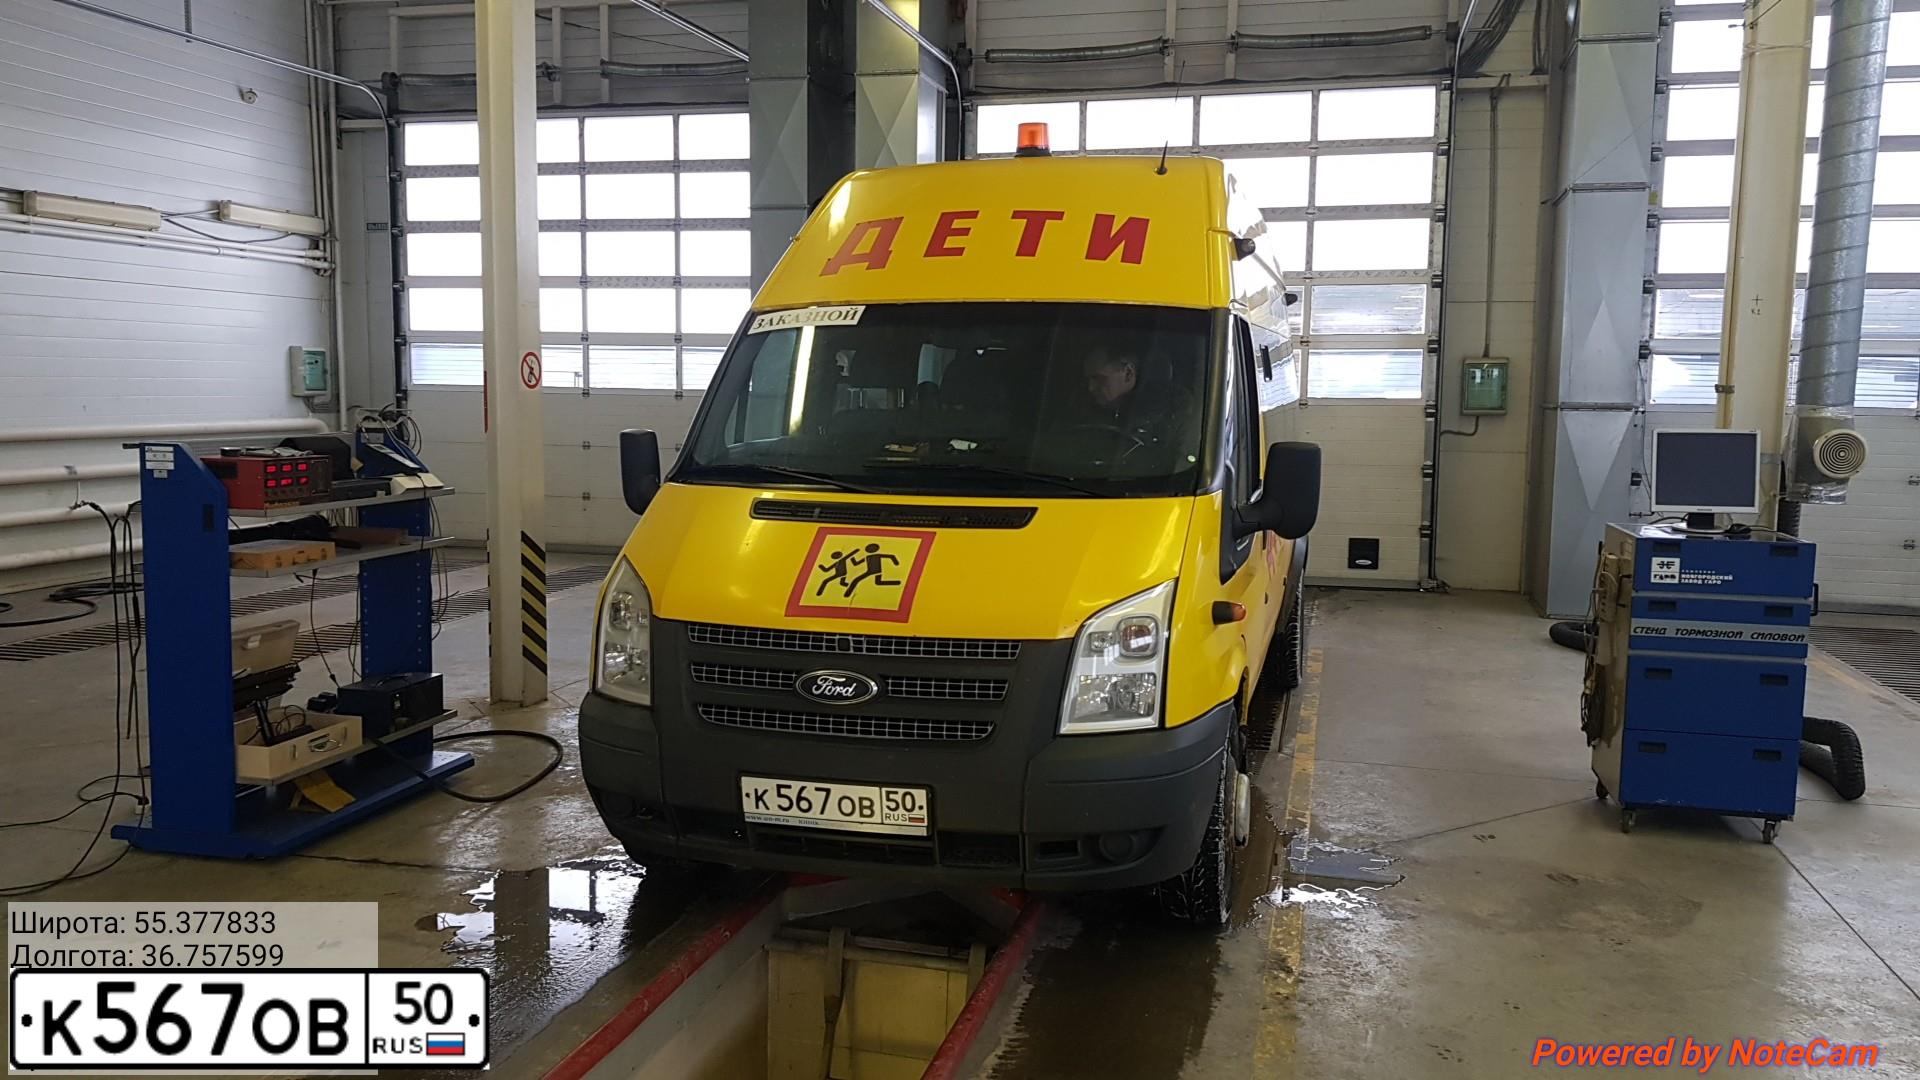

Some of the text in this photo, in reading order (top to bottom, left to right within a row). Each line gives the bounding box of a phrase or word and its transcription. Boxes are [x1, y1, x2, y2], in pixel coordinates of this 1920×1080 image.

[820, 209, 1150, 277] ДЕТИ
[752, 307, 859, 330] ЗАКАЗНОЙ
[1632, 625, 1806, 643] СТЕНД ТОРМОЗНОЙ СИЛОВОЙ
[812, 675, 857, 697] Ford
[885, 790, 916, 813] 50
[884, 813, 908, 823] RUS
